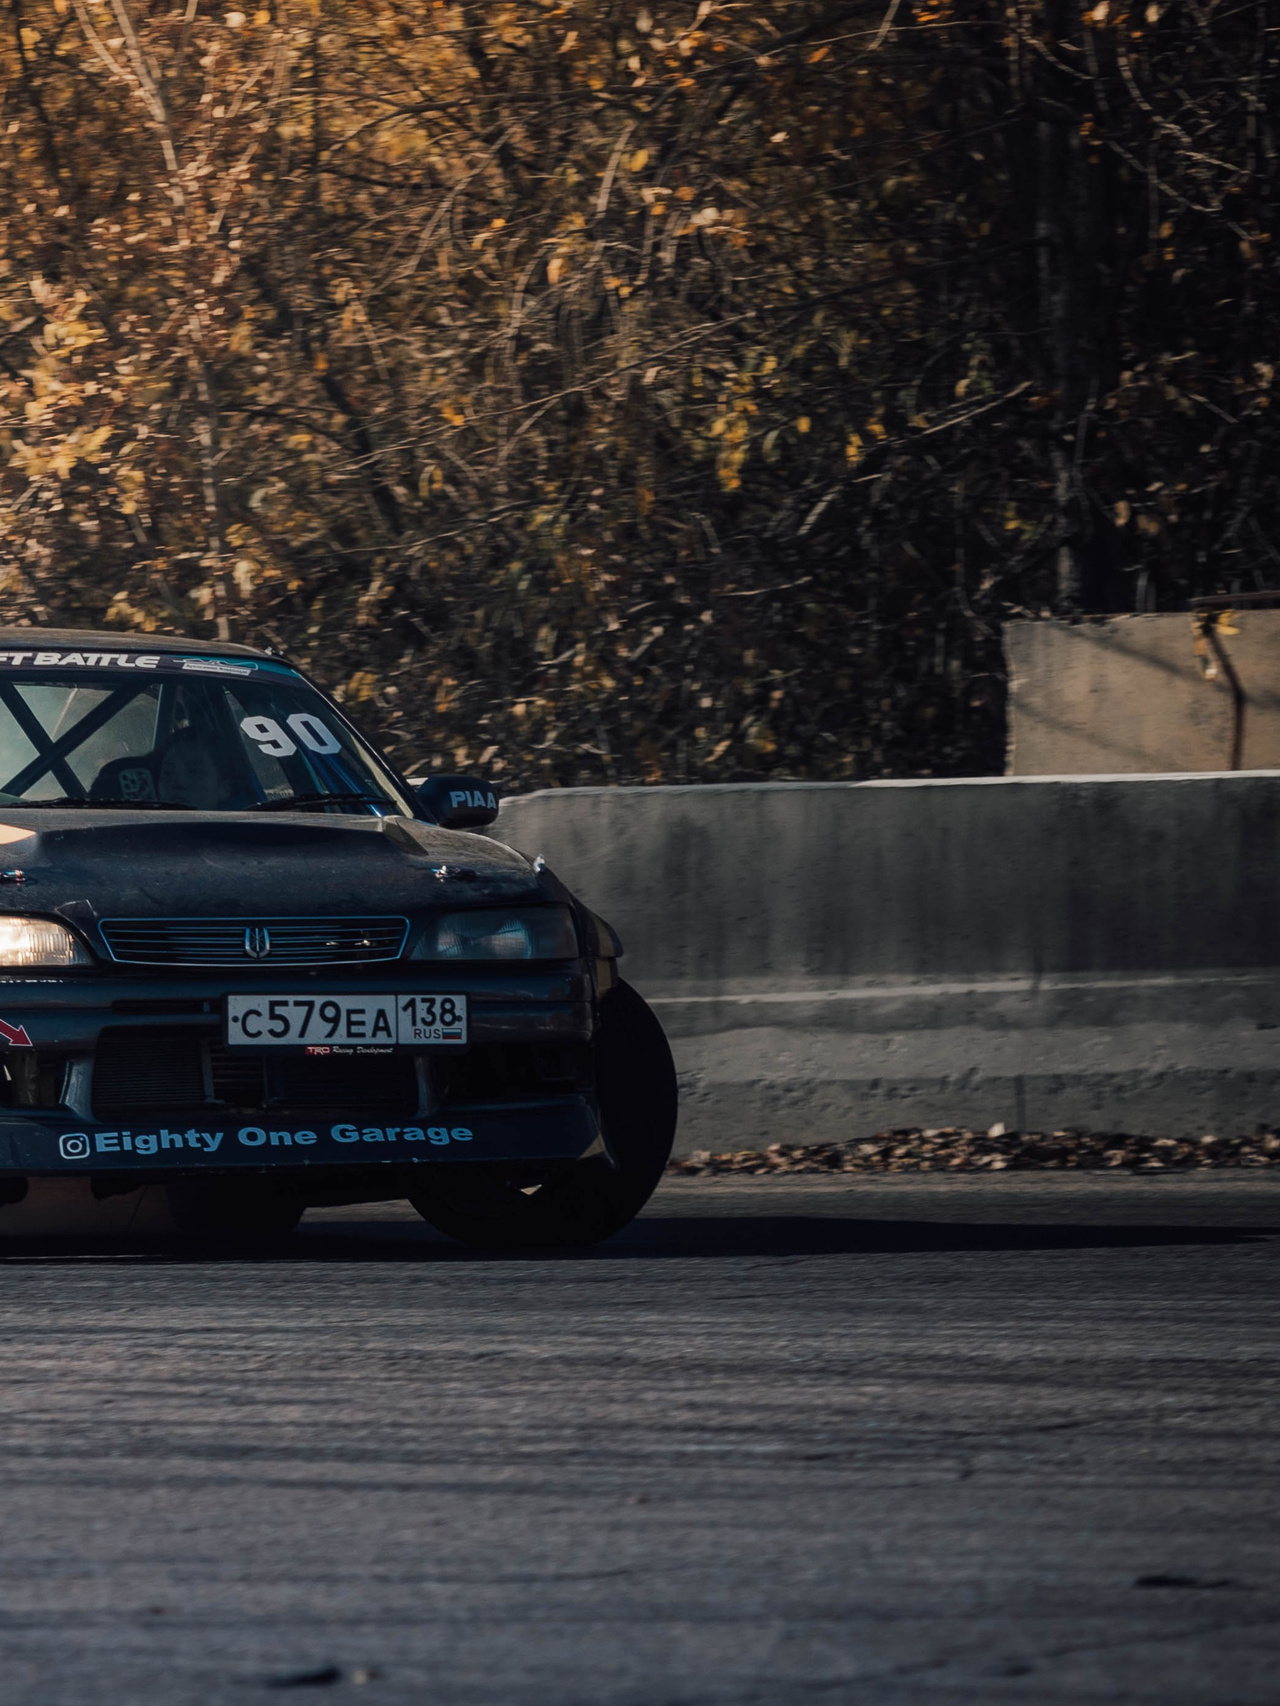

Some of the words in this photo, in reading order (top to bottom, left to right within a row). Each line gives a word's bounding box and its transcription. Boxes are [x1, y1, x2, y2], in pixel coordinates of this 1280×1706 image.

[240, 713, 342, 757] 90
[449, 790, 497, 809] PIAA
[401, 998, 457, 1027] 138
[414, 1028, 441, 1040] RUS
[307, 1046, 330, 1055] TRD
[95, 1128, 223, 1154] Eighty
[237, 1127, 317, 1145] One
[331, 1124, 474, 1145] Garage
